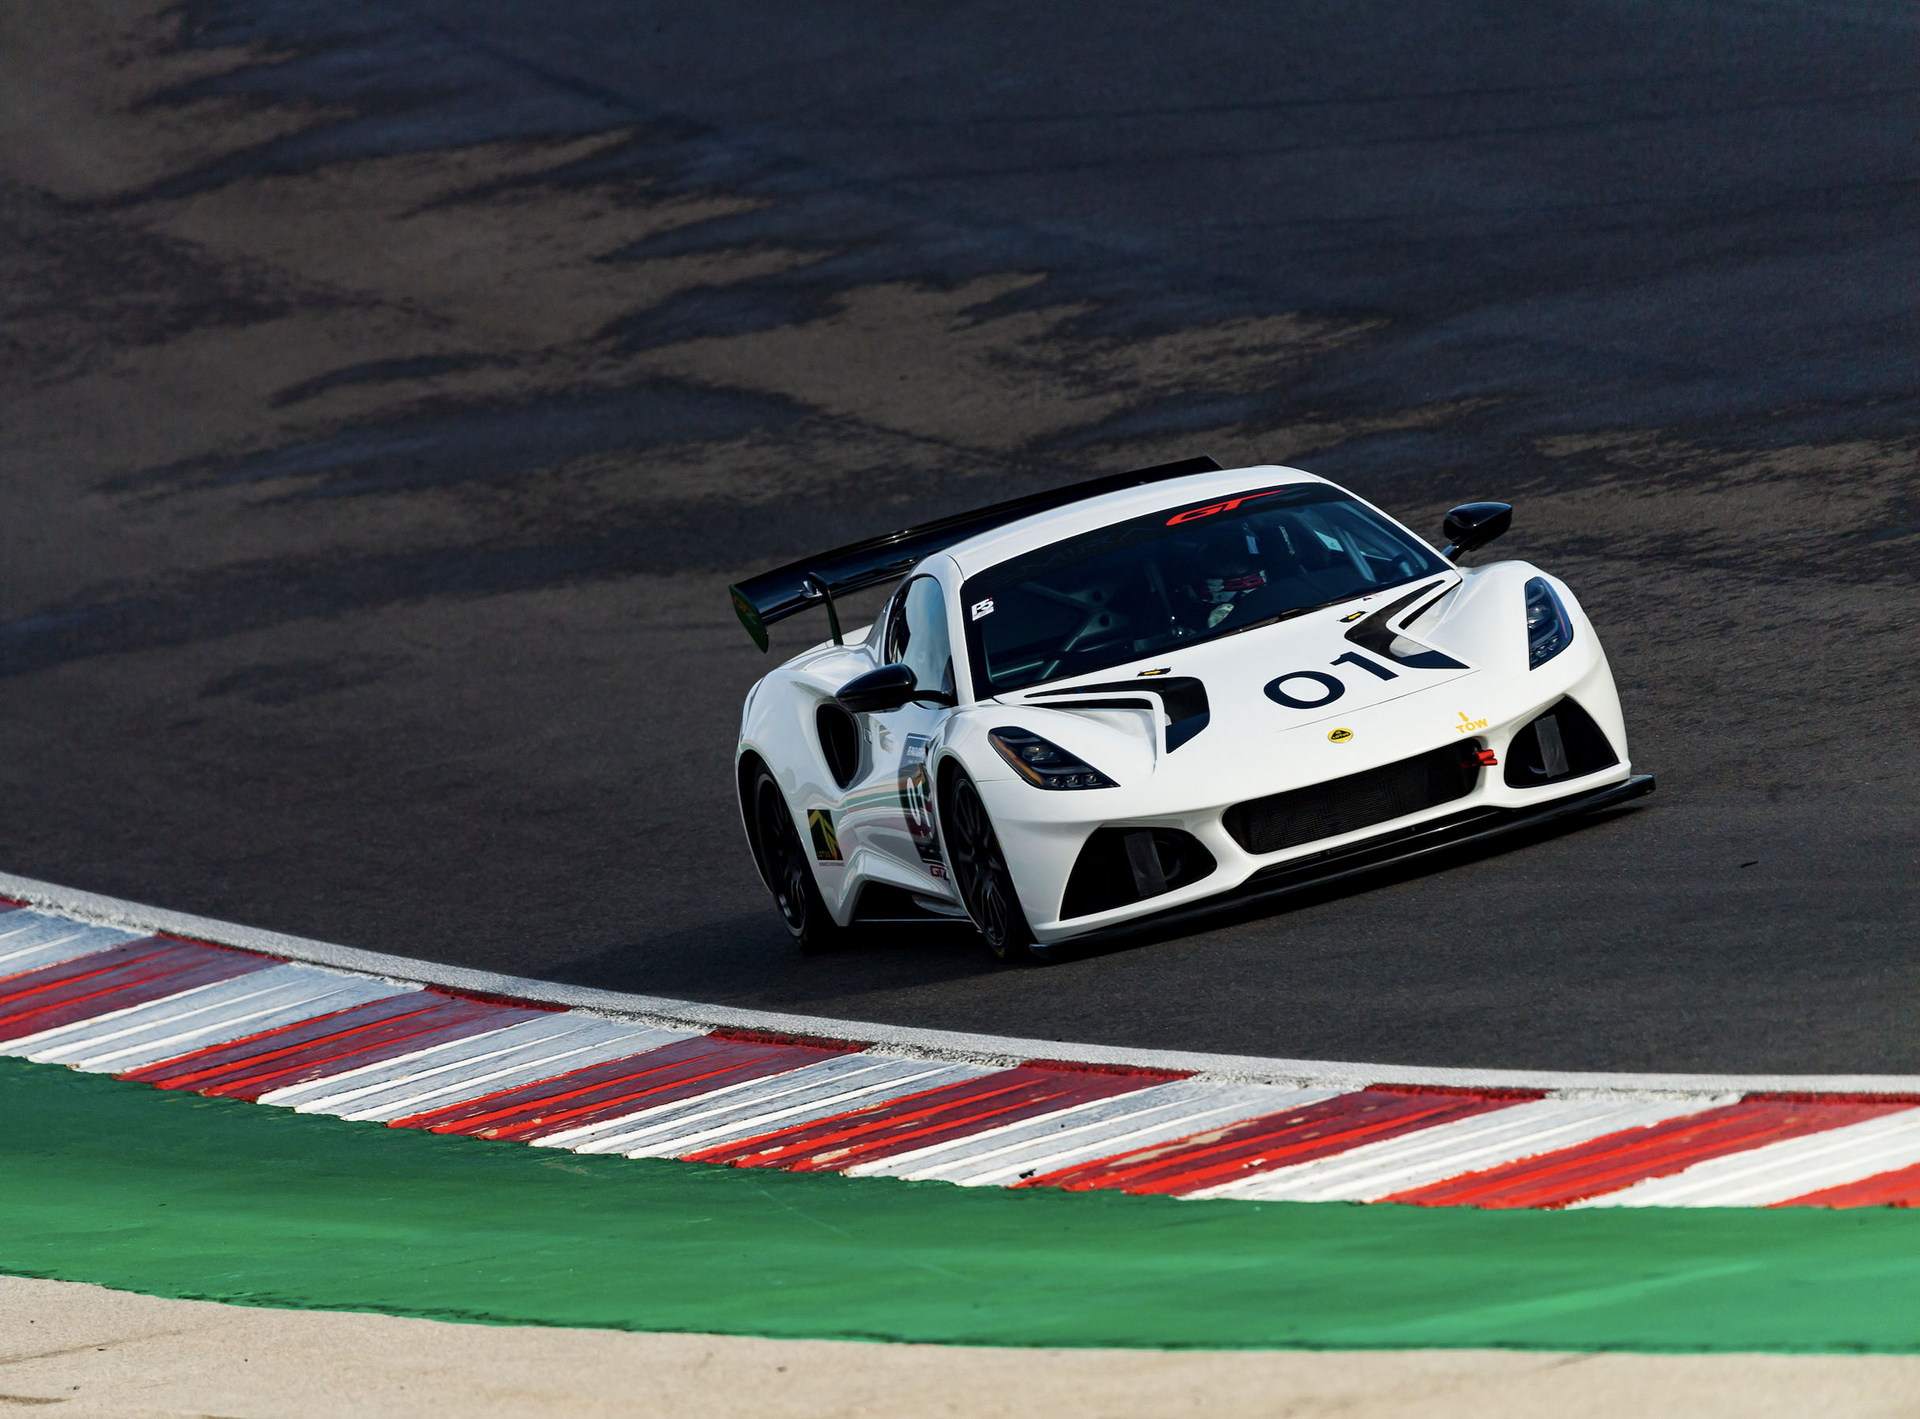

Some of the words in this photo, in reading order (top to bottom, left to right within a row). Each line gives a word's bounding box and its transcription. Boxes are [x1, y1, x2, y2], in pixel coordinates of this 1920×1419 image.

[1165, 489, 1285, 526] GT
[1263, 651, 1400, 710] 01
[1455, 718, 1488, 733] TOW
